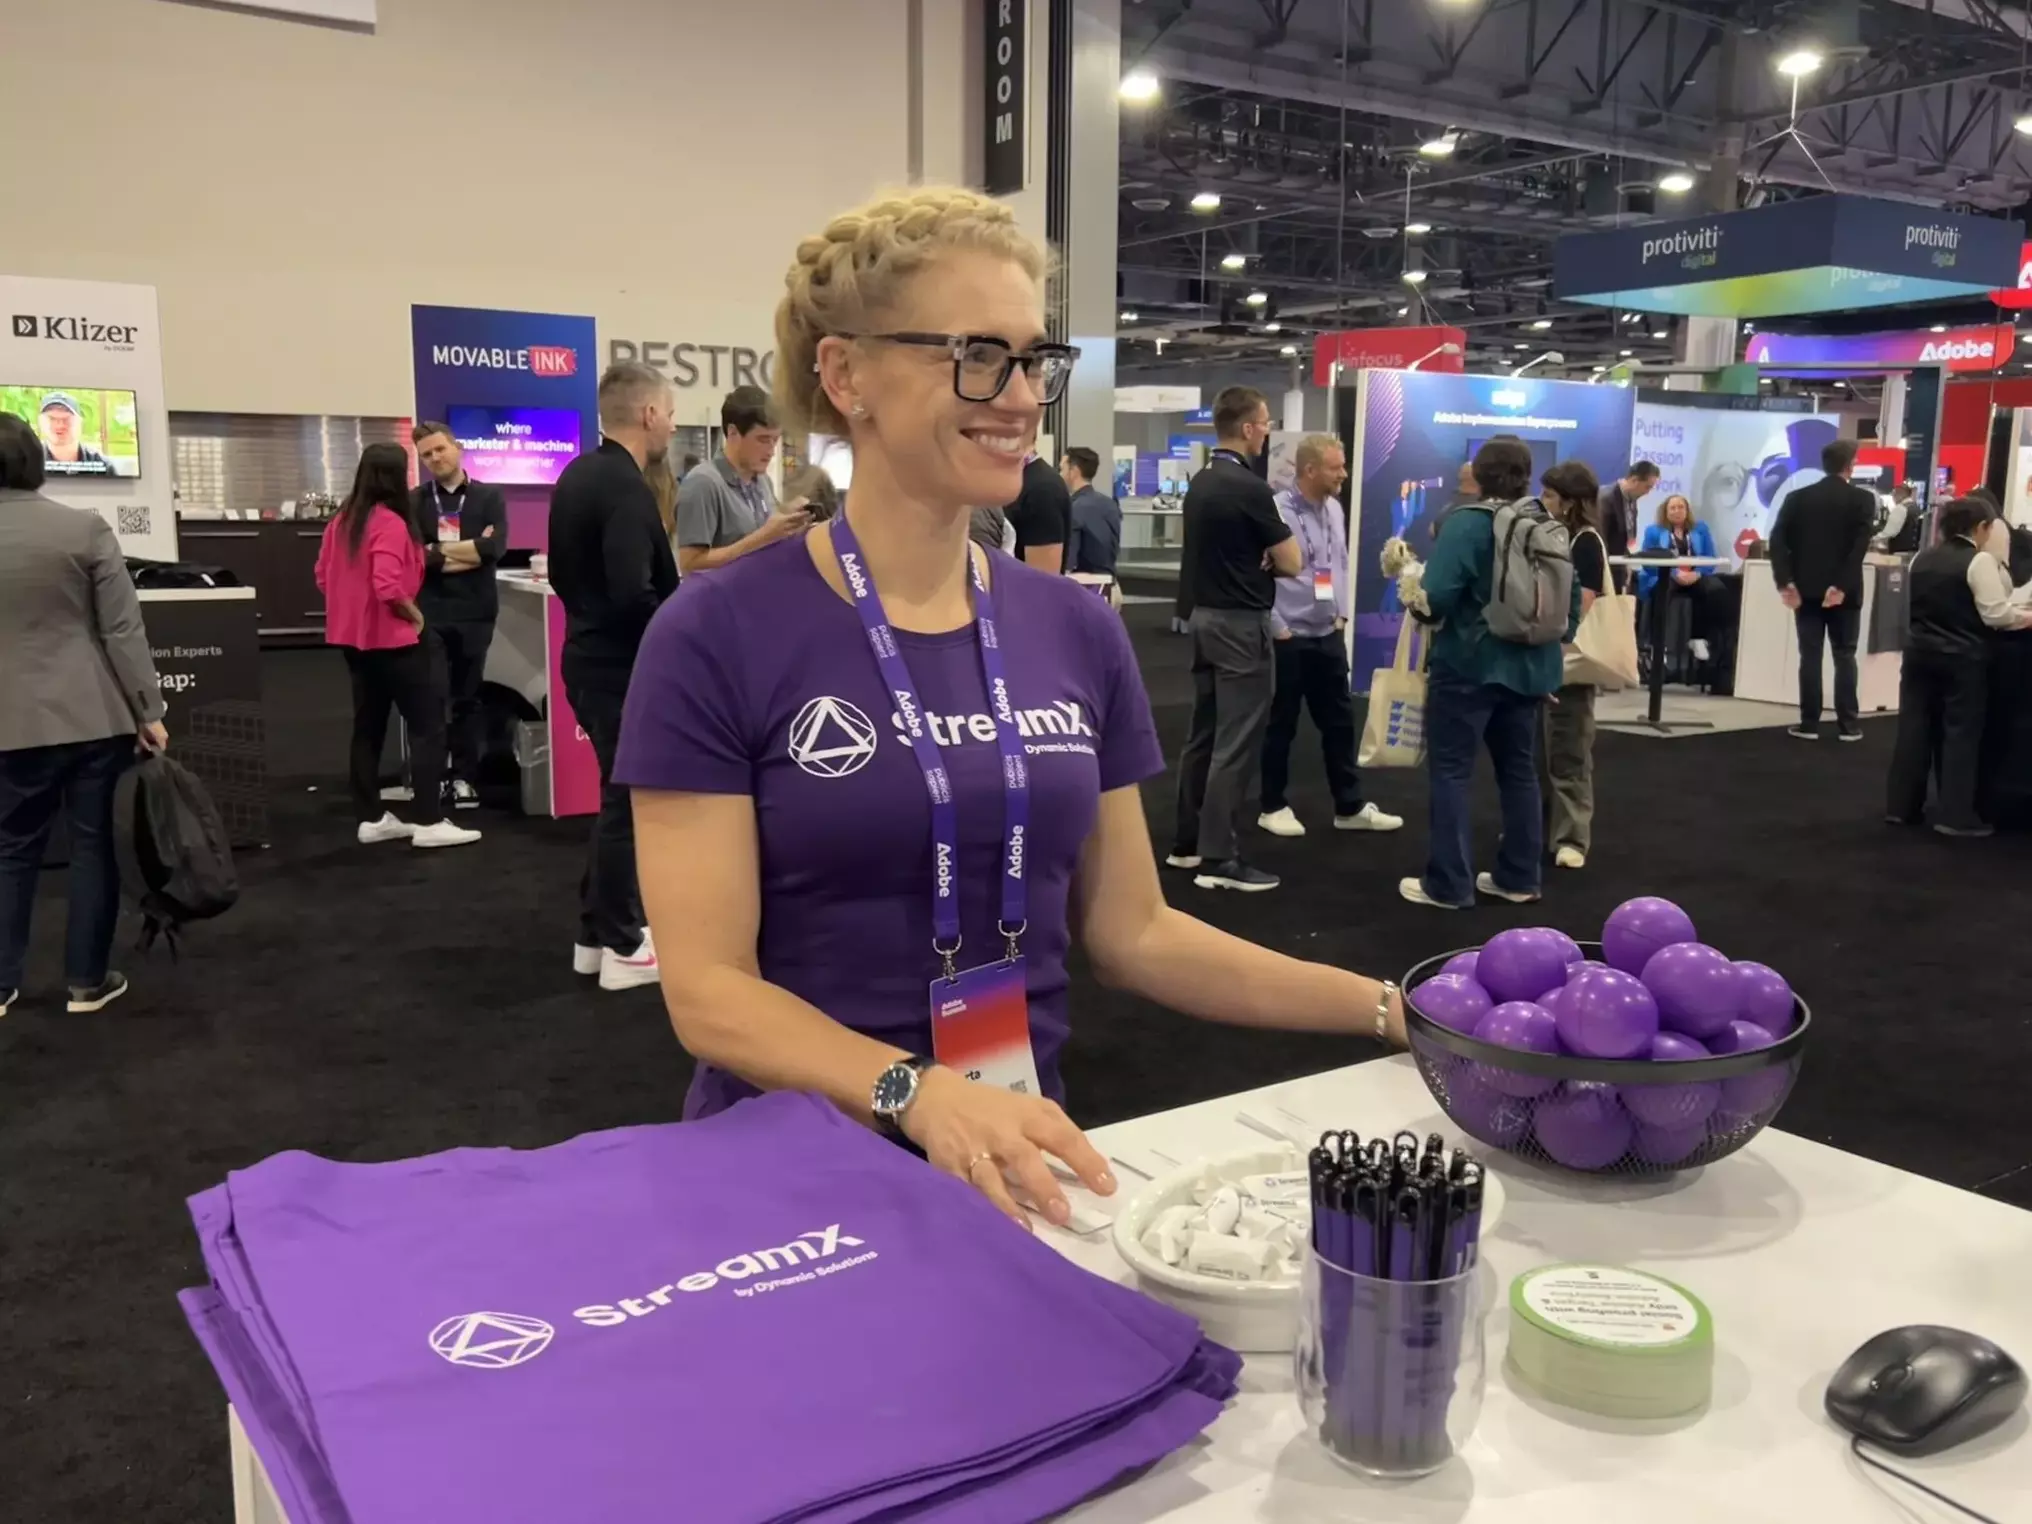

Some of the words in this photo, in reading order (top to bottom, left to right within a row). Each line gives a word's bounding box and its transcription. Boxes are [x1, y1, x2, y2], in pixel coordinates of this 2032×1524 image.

[1642, 225, 1719, 265] protiviti
[1904, 224, 1960, 251] protiviti
[42, 316, 138, 344] Klizer
[432, 345, 529, 370] MOVABLE
[535, 352, 569, 372] INK
[1919, 339, 1993, 362] Adobe
[495, 422, 533, 435] where
[1635, 418, 1684, 444] Putting
[525, 440, 575, 453] machine
[1634, 446, 1683, 467] Passion
[841, 553, 868, 598] Adobe
[174, 646, 222, 658] Experts
[894, 690, 923, 737] Adobe
[993, 678, 1014, 724] Adobe
[1007, 825, 1024, 879] Adobe
[937, 842, 952, 898] Adobe
[573, 1224, 865, 1327] StreamX
[733, 1287, 755, 1297] by
[754, 1272, 817, 1292] Dynamic
[815, 1251, 879, 1276] Solutions
